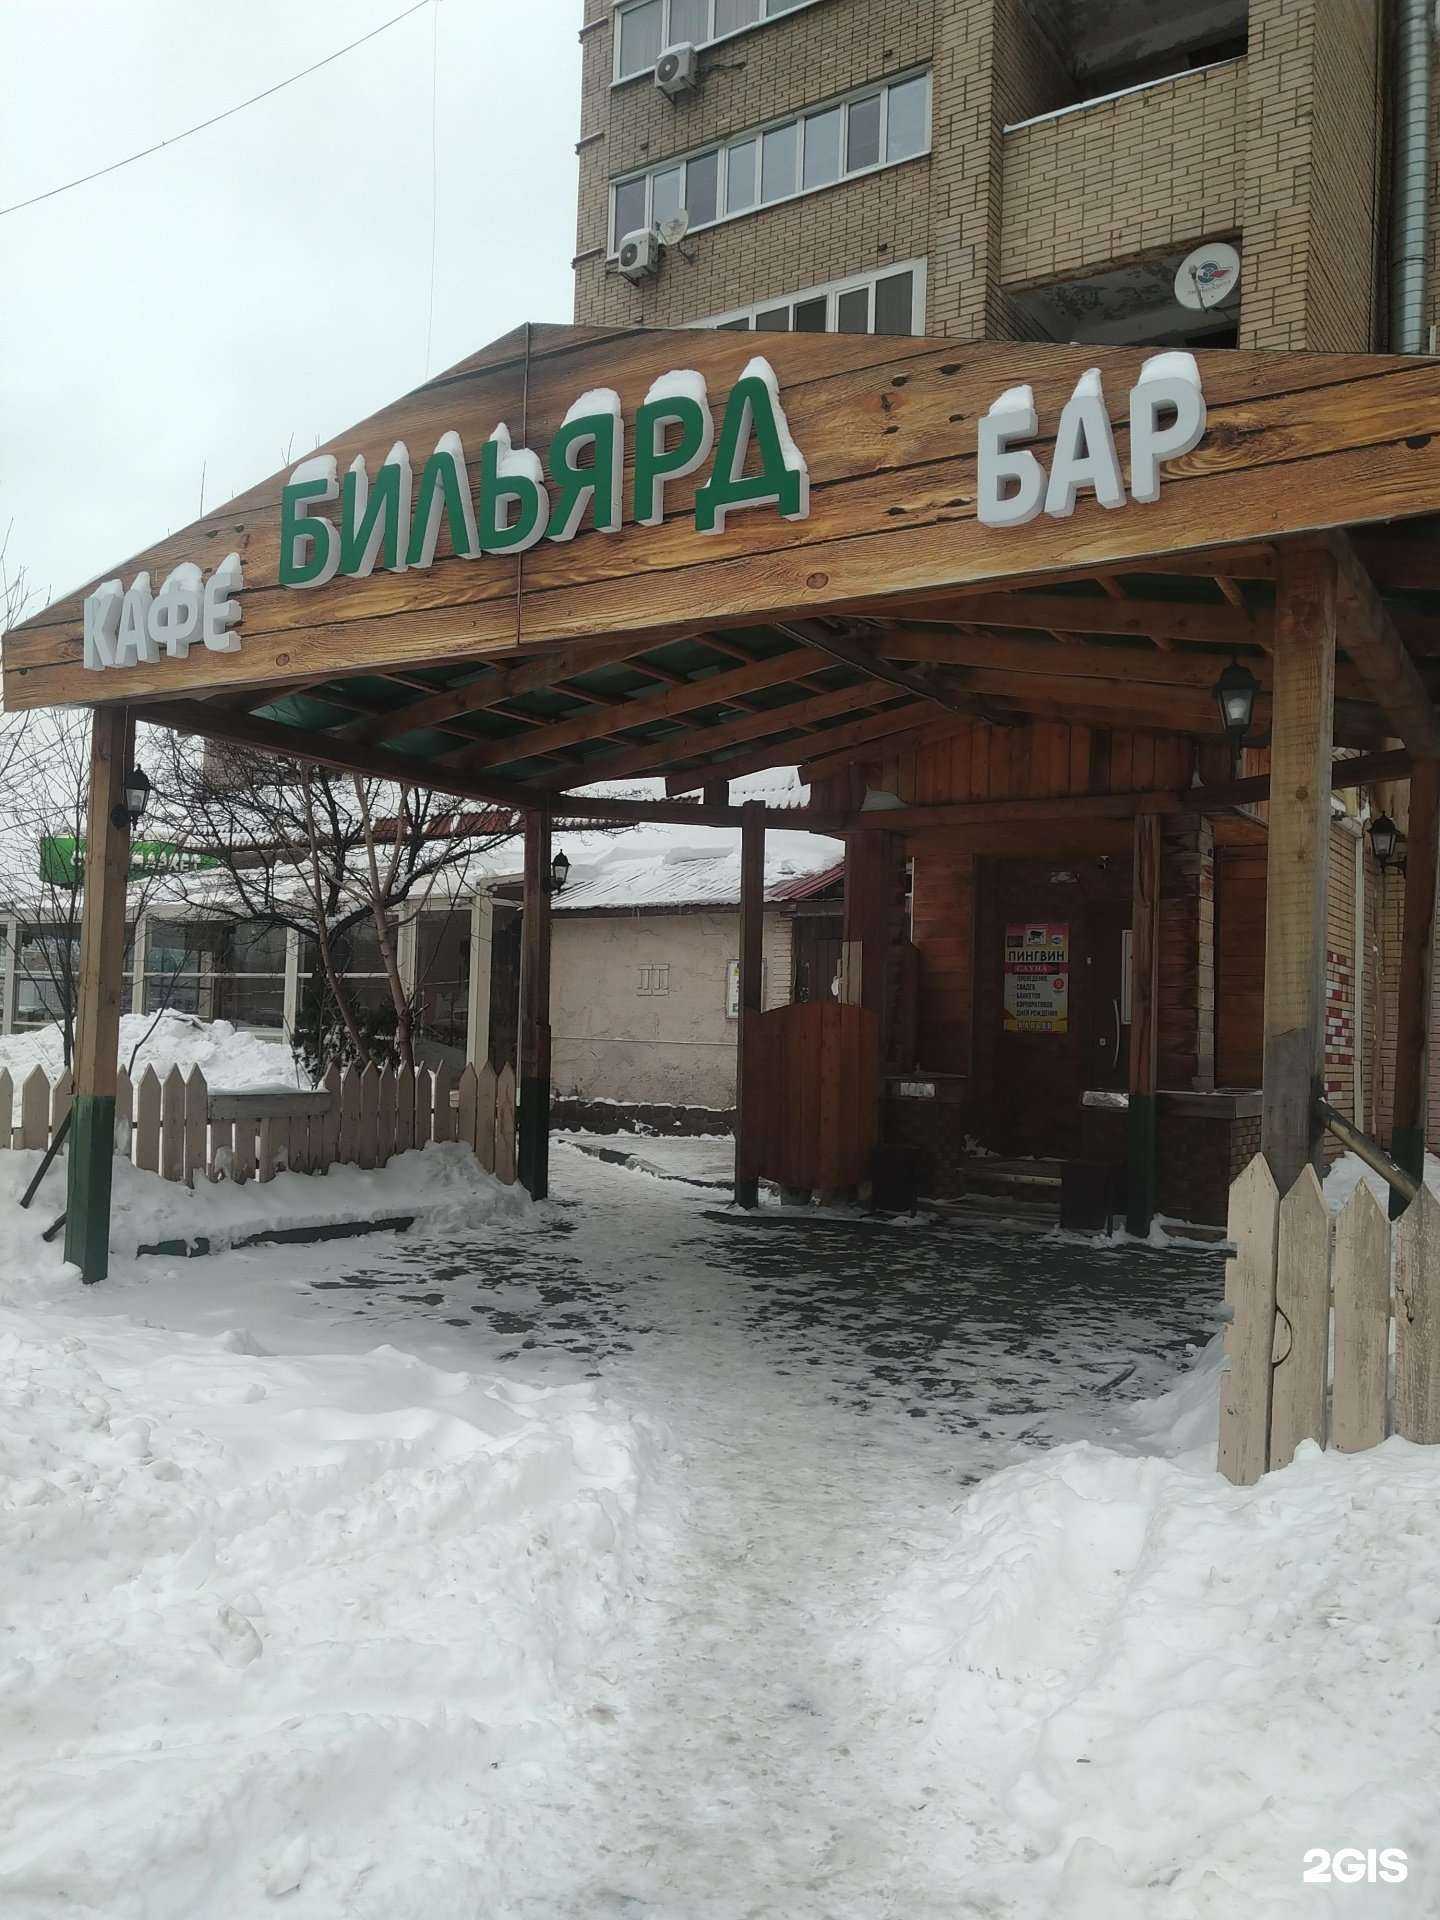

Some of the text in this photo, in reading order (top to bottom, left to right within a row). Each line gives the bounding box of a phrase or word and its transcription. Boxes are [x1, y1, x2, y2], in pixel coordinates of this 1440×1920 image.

[279, 370, 809, 588] БИЛЬЯРД
[977, 372, 1207, 528] БАР
[83, 560, 243, 671] КАФЕ
[1008, 950, 1065, 962] ПИНГВИН
